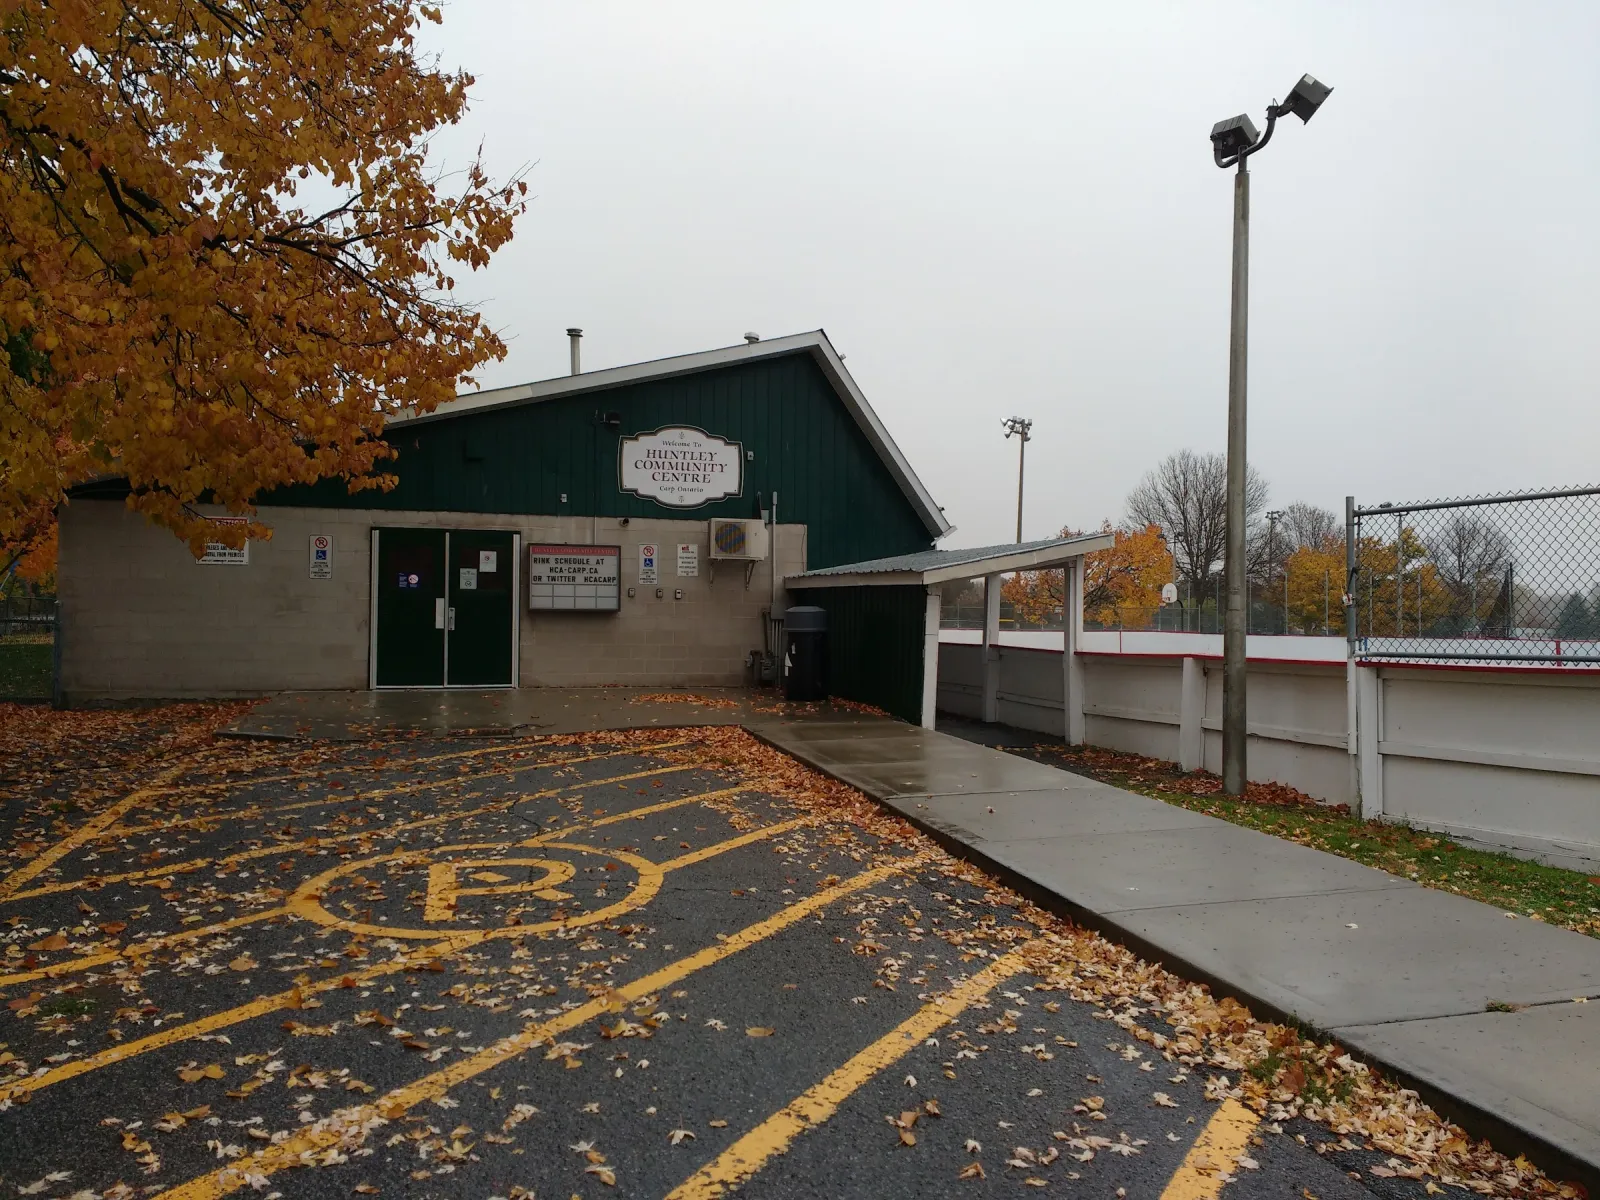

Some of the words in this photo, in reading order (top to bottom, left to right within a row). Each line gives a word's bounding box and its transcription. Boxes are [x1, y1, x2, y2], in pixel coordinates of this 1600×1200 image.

[646, 449, 717, 461] HUNTLEY
[634, 460, 727, 472] COMMUNITY
[652, 472, 711, 483] CENTRE
[659, 485, 675, 494] Carp
[554, 557, 590, 565] SCHEDULE
[546, 575, 576, 583] TWITTER
